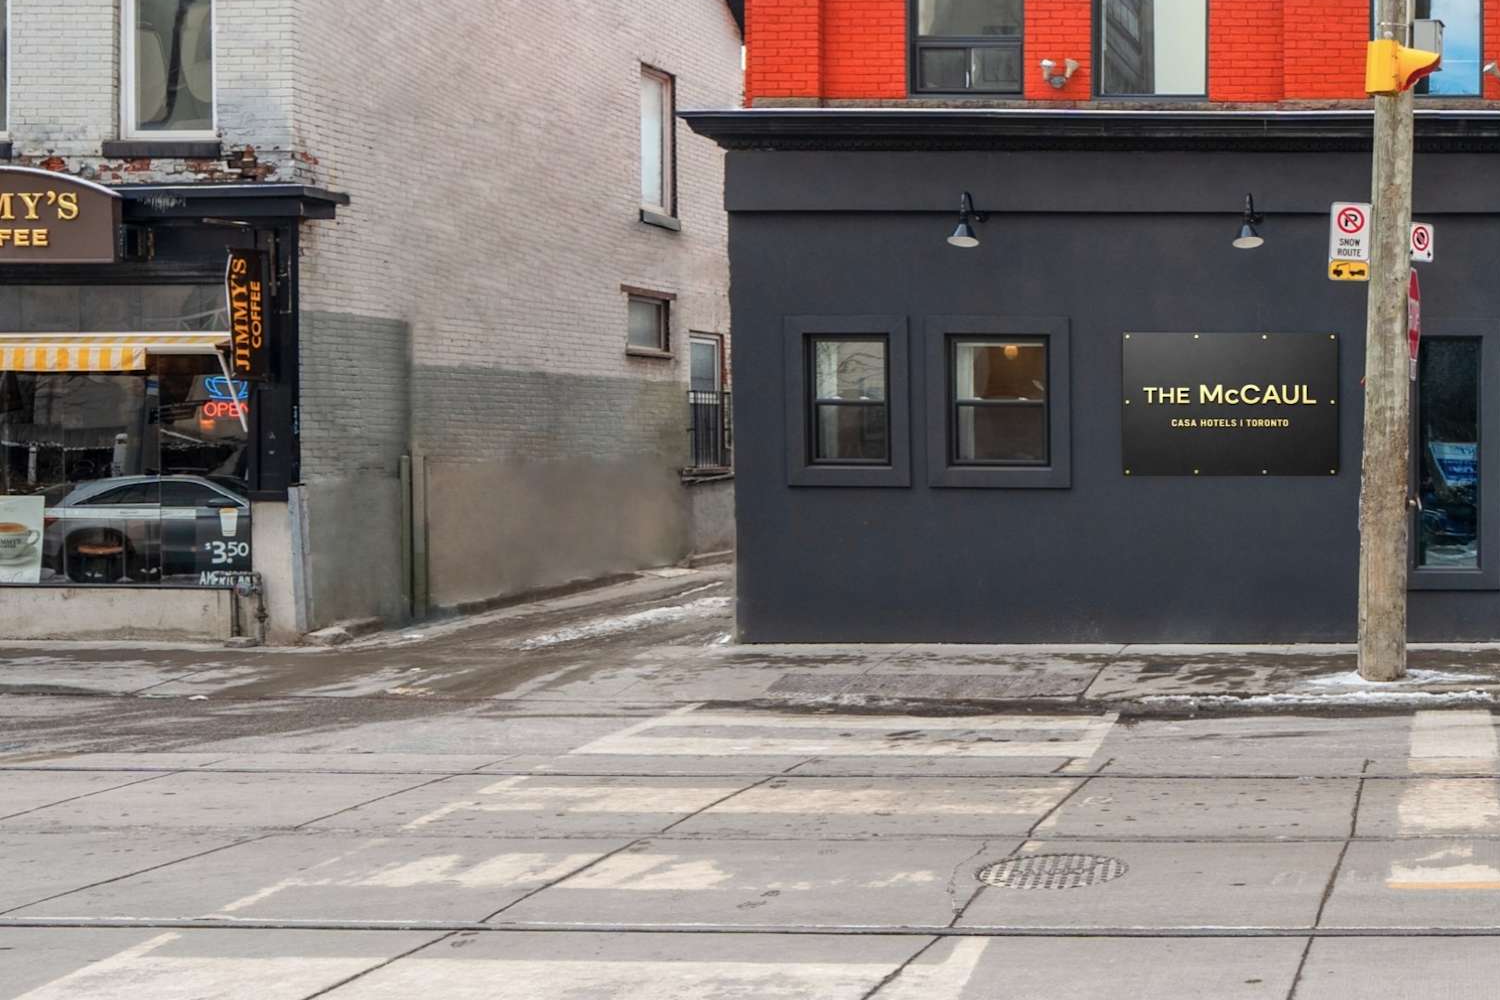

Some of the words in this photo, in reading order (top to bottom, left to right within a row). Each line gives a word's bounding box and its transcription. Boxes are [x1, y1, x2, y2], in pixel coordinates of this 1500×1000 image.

[1339, 238, 1361, 247] SNOW
[1337, 248, 1362, 258] ROUTE
[231, 257, 251, 371] JIMMY'S
[250, 280, 263, 349] COFFEE
[1143, 386, 1191, 404] THE
[1199, 384, 1318, 405] McCAUL
[1171, 418, 1198, 428] CASA
[1200, 418, 1238, 428] HOTELS
[1246, 418, 1290, 428] TORONTO
